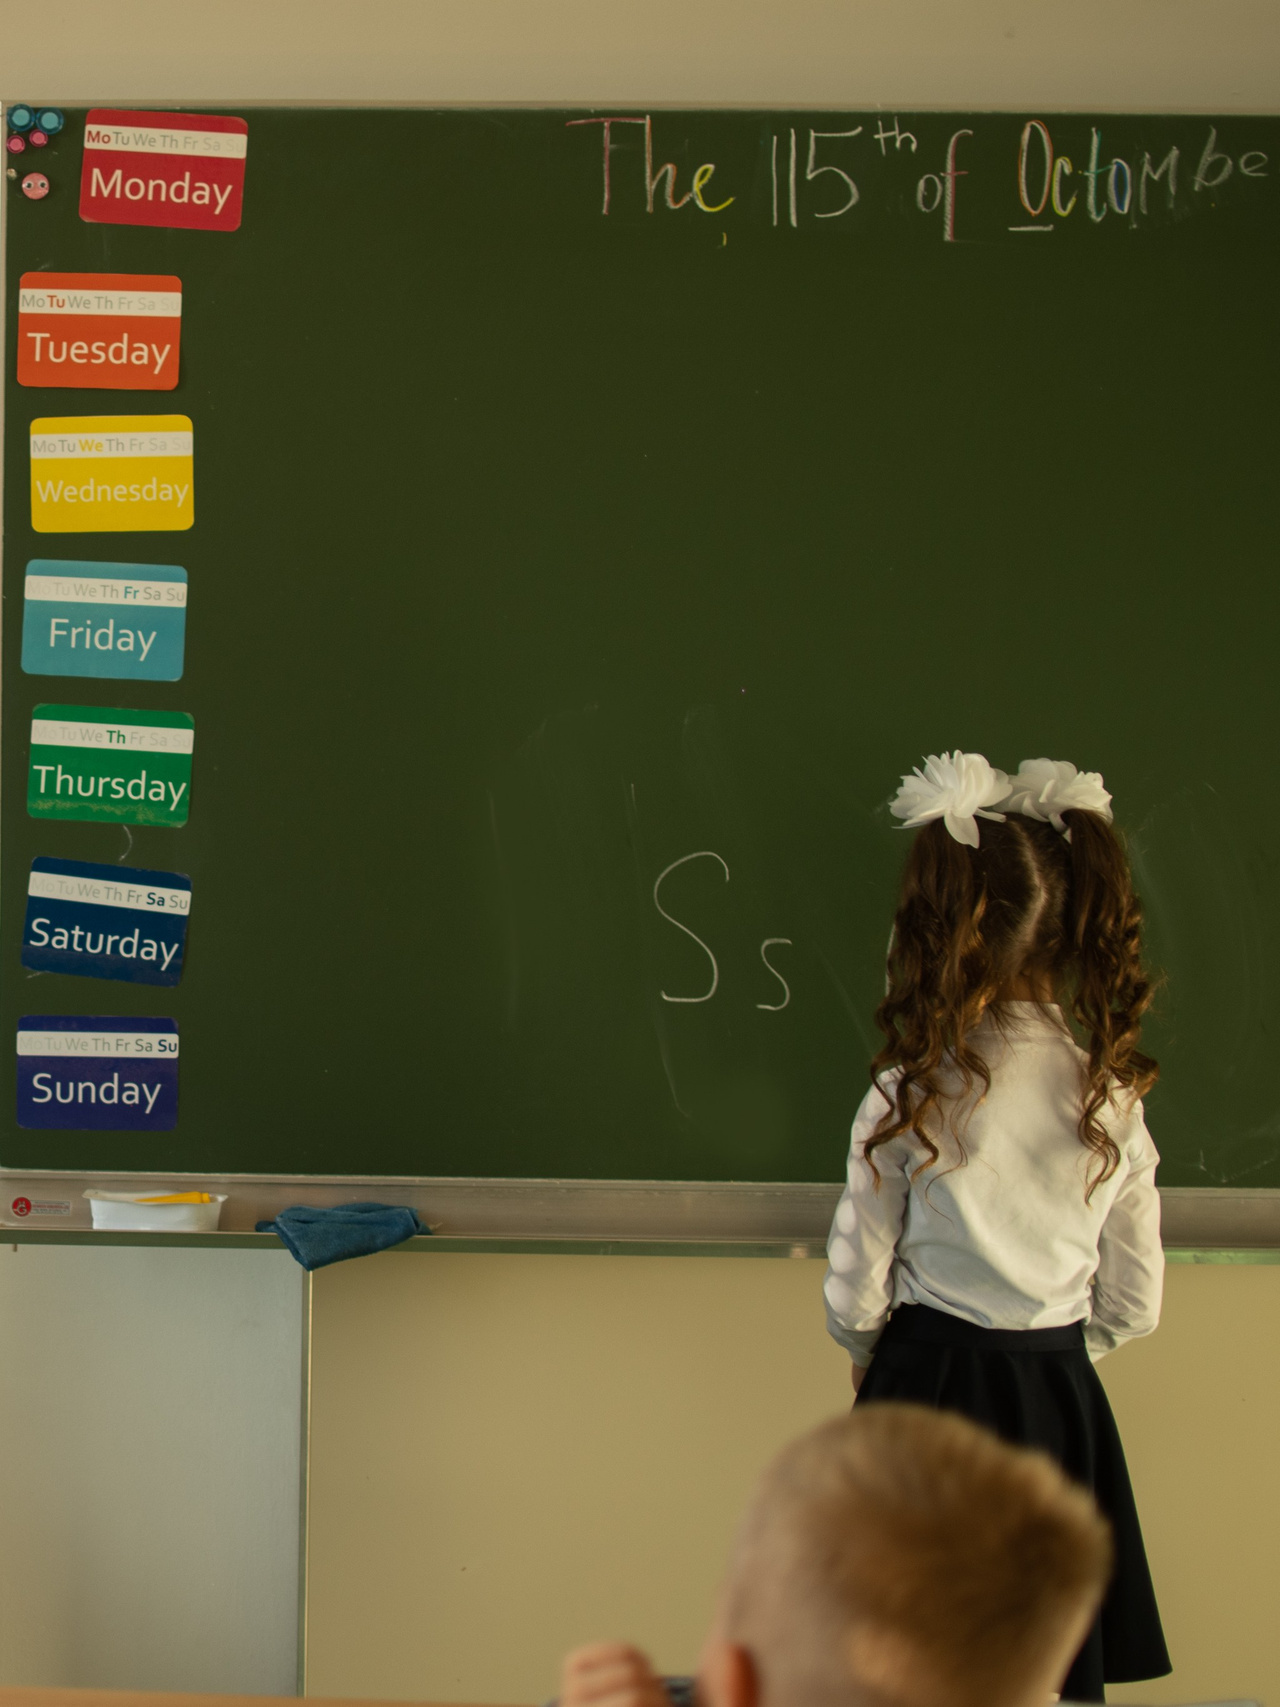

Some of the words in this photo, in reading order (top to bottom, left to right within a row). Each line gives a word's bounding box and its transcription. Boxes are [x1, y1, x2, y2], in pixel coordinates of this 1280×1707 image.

[87, 131, 111, 144] Mo
[113, 132, 130, 146] Tu
[131, 133, 156, 147] We
[160, 135, 178, 148] Th
[184, 136, 198, 150] Fr
[203, 137, 220, 151] Sa
[91, 168, 233, 215] Monday
[565, 114, 736, 215] The
[916, 128, 974, 242] of
[21, 295, 45, 307] Mo
[47, 295, 65, 308] Tu
[68, 296, 91, 309] We
[94, 297, 113, 310] Th
[118, 298, 132, 310] Fr
[138, 298, 155, 311] Sa
[27, 333, 171, 374] Tuesday
[33, 440, 56, 453] Mo
[59, 440, 75, 452] Tu
[79, 439, 103, 452] We
[106, 438, 125, 451] Th
[130, 439, 144, 451] Fr
[149, 438, 167, 451] Sa
[36, 477, 189, 508] Wednesday
[74, 584, 97, 597] We
[101, 585, 118, 598] Th
[124, 586, 139, 599] Fr
[144, 587, 161, 600] Sa
[166, 588, 184, 601] Su
[50, 618, 157, 661] Friday
[80, 729, 103, 742] We
[107, 730, 126, 744] Th
[131, 732, 145, 745] Fr
[33, 764, 187, 811] Thursday
[77, 883, 100, 898] We
[104, 887, 122, 901] Th
[127, 890, 142, 904] Fr
[146, 892, 165, 906] Sa
[169, 895, 188, 909] Su
[29, 917, 179, 971] Saturday
[65, 1039, 88, 1051] We
[92, 1039, 111, 1051] Th
[117, 1039, 131, 1052] Fr
[135, 1040, 152, 1052] Sa
[158, 1040, 177, 1052] Su
[32, 1072, 162, 1114] Sunday
